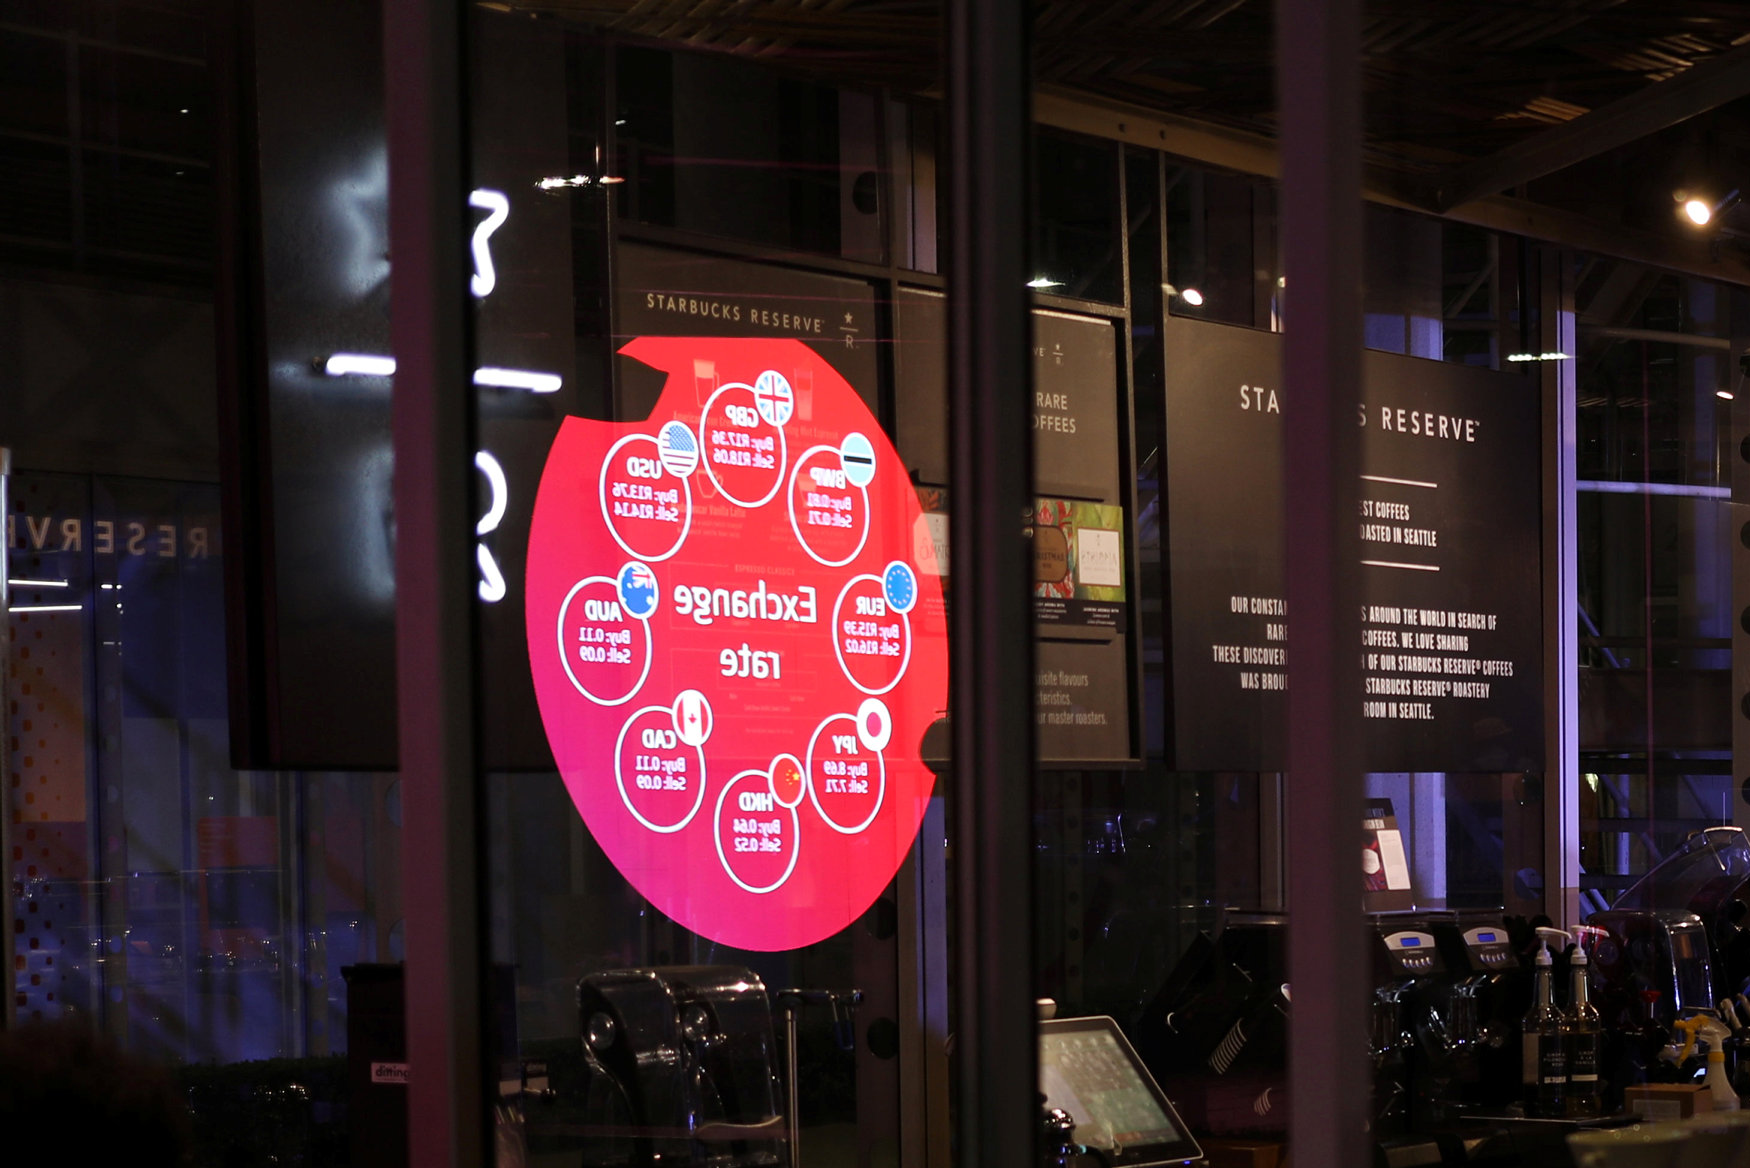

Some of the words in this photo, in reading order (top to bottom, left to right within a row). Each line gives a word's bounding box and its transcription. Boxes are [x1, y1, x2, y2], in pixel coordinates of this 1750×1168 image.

[647, 292, 741, 321] STARBUCKS
[1036, 391, 1068, 411] RARE
[1375, 501, 1410, 522] COFFEES
[1392, 526, 1402, 544] IN
[1403, 528, 1437, 548] SEATTLE
[1231, 596, 1249, 614] OUR
[1369, 606, 1400, 624] AROUND
[1403, 608, 1418, 626] THE
[1419, 609, 1446, 628] WORLD
[1447, 612, 1456, 628] IN
[1457, 612, 1486, 630] SEARCH
[1487, 614, 1497, 631] OF
[1401, 632, 1414, 649] WE
[1415, 633, 1435, 650] LOVE
[1436, 634, 1469, 652] SHARING
[1212, 645, 1241, 664] THESE
[1367, 653, 1378, 671] OF
[1380, 654, 1397, 671] OUR
[1398, 655, 1442, 673] STARBUCKS
[1482, 659, 1514, 677] COFFEES
[1240, 672, 1260, 689] WAS
[1365, 677, 1411, 695] STARBUCKS
[1452, 681, 1491, 699] ROASTERY
[1388, 702, 1397, 719] IN
[1399, 702, 1434, 720] SEATTLE.
